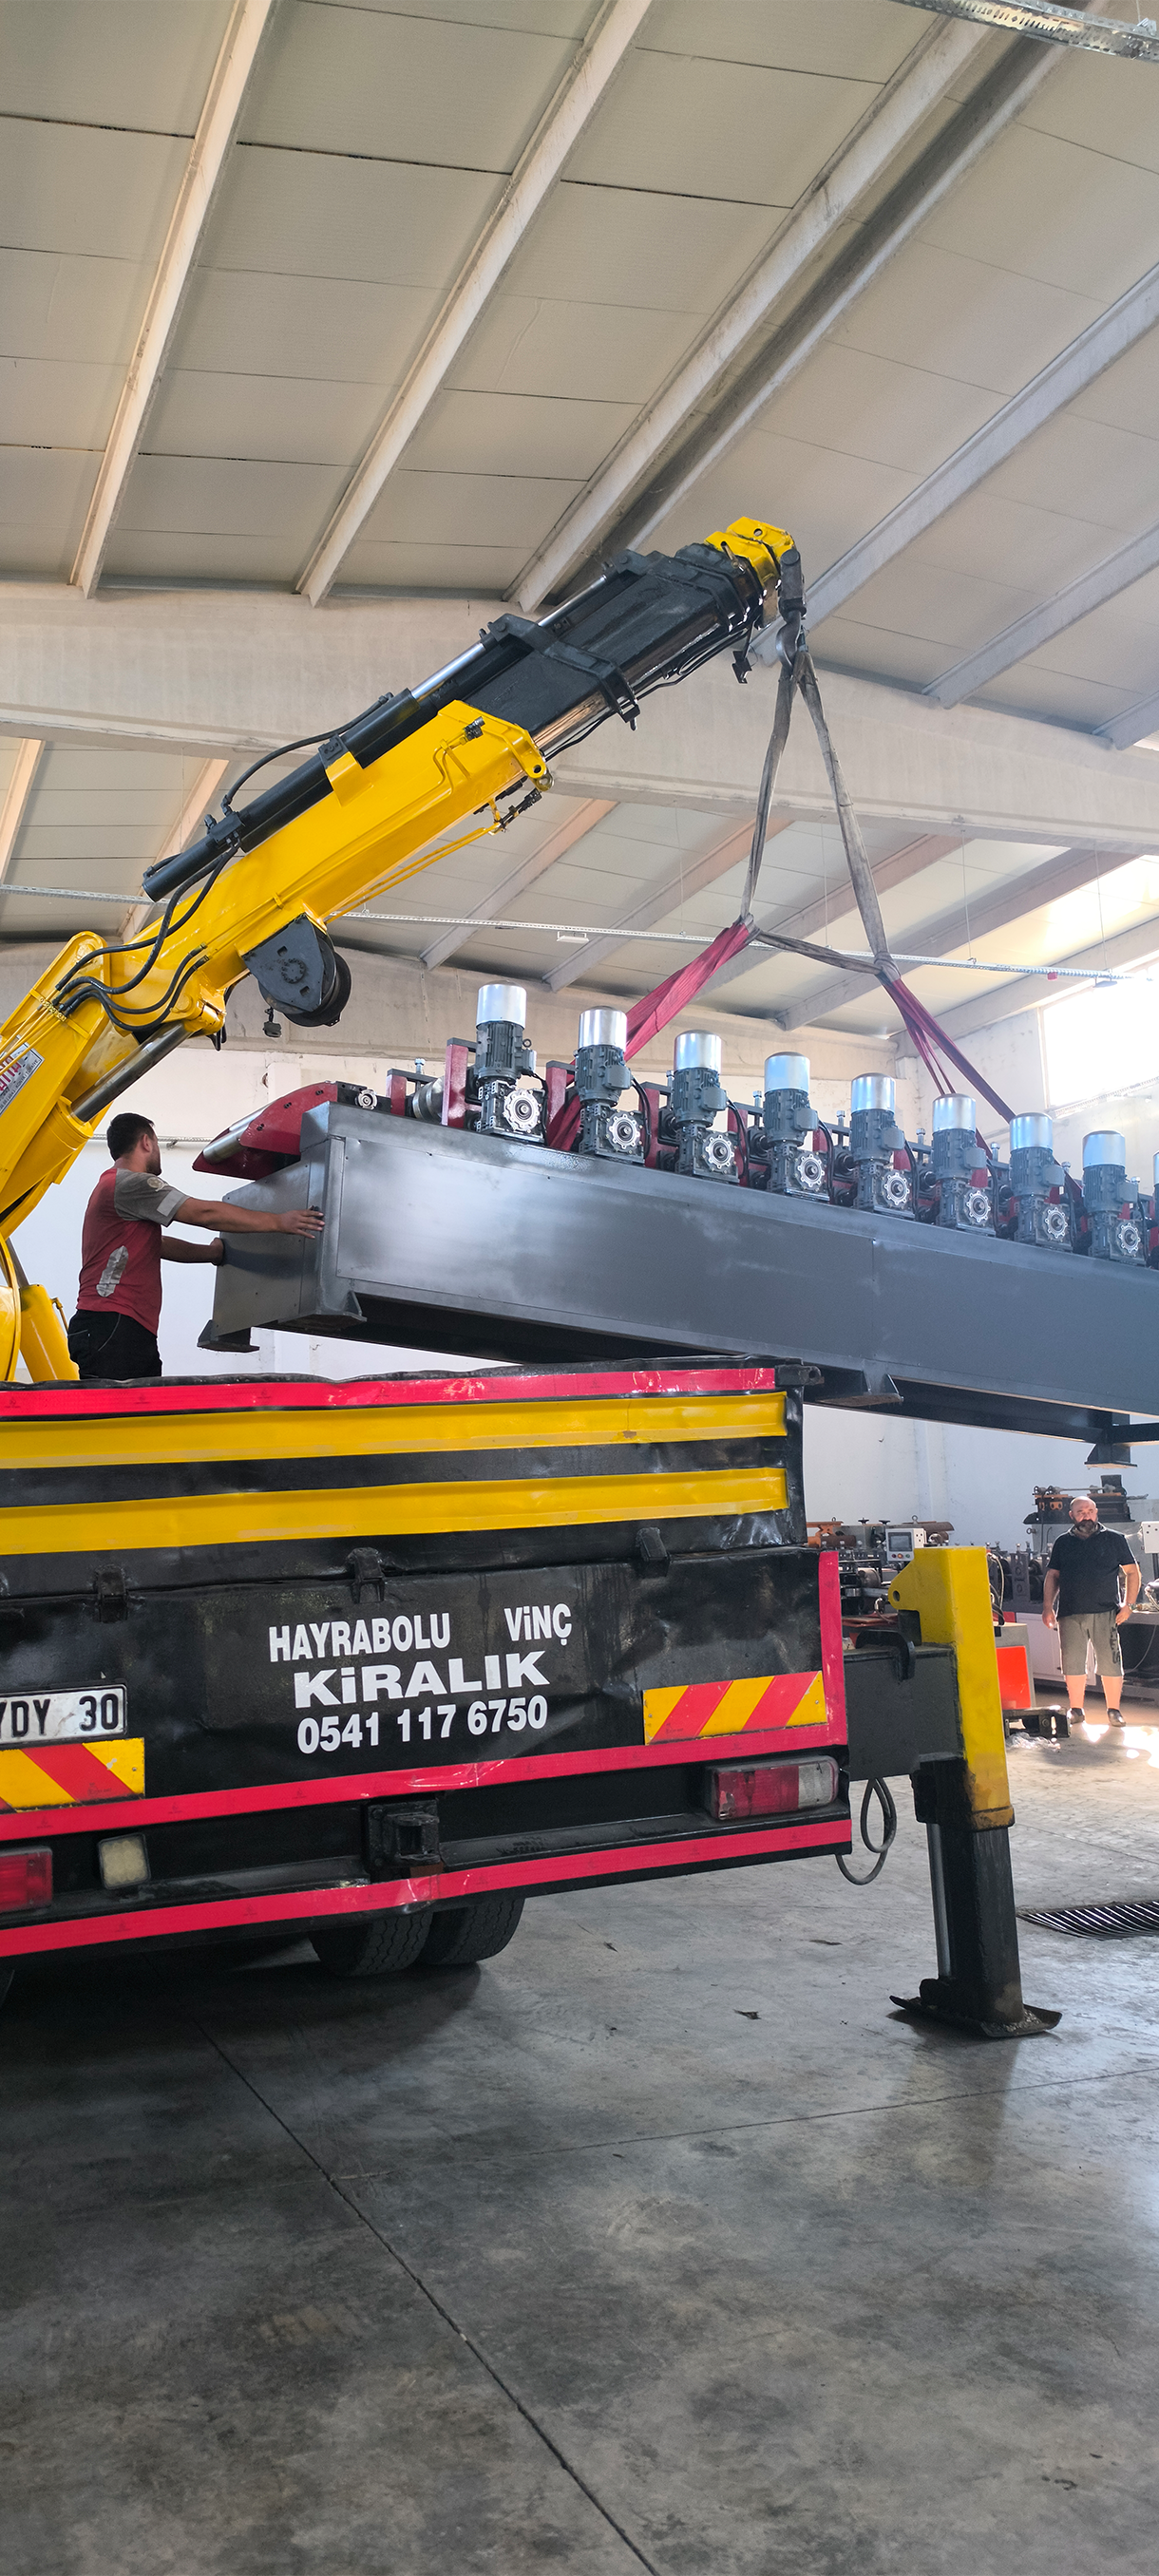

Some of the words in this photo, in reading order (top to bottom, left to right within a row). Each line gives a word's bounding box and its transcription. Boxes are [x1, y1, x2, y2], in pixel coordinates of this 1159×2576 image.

[269, 1613, 451, 1662] HAYRABOLU
[79, 1694, 119, 1732] 30
[297, 1711, 379, 1753] 0541
[397, 1704, 456, 1742] 117
[467, 1695, 548, 1735] 6750
